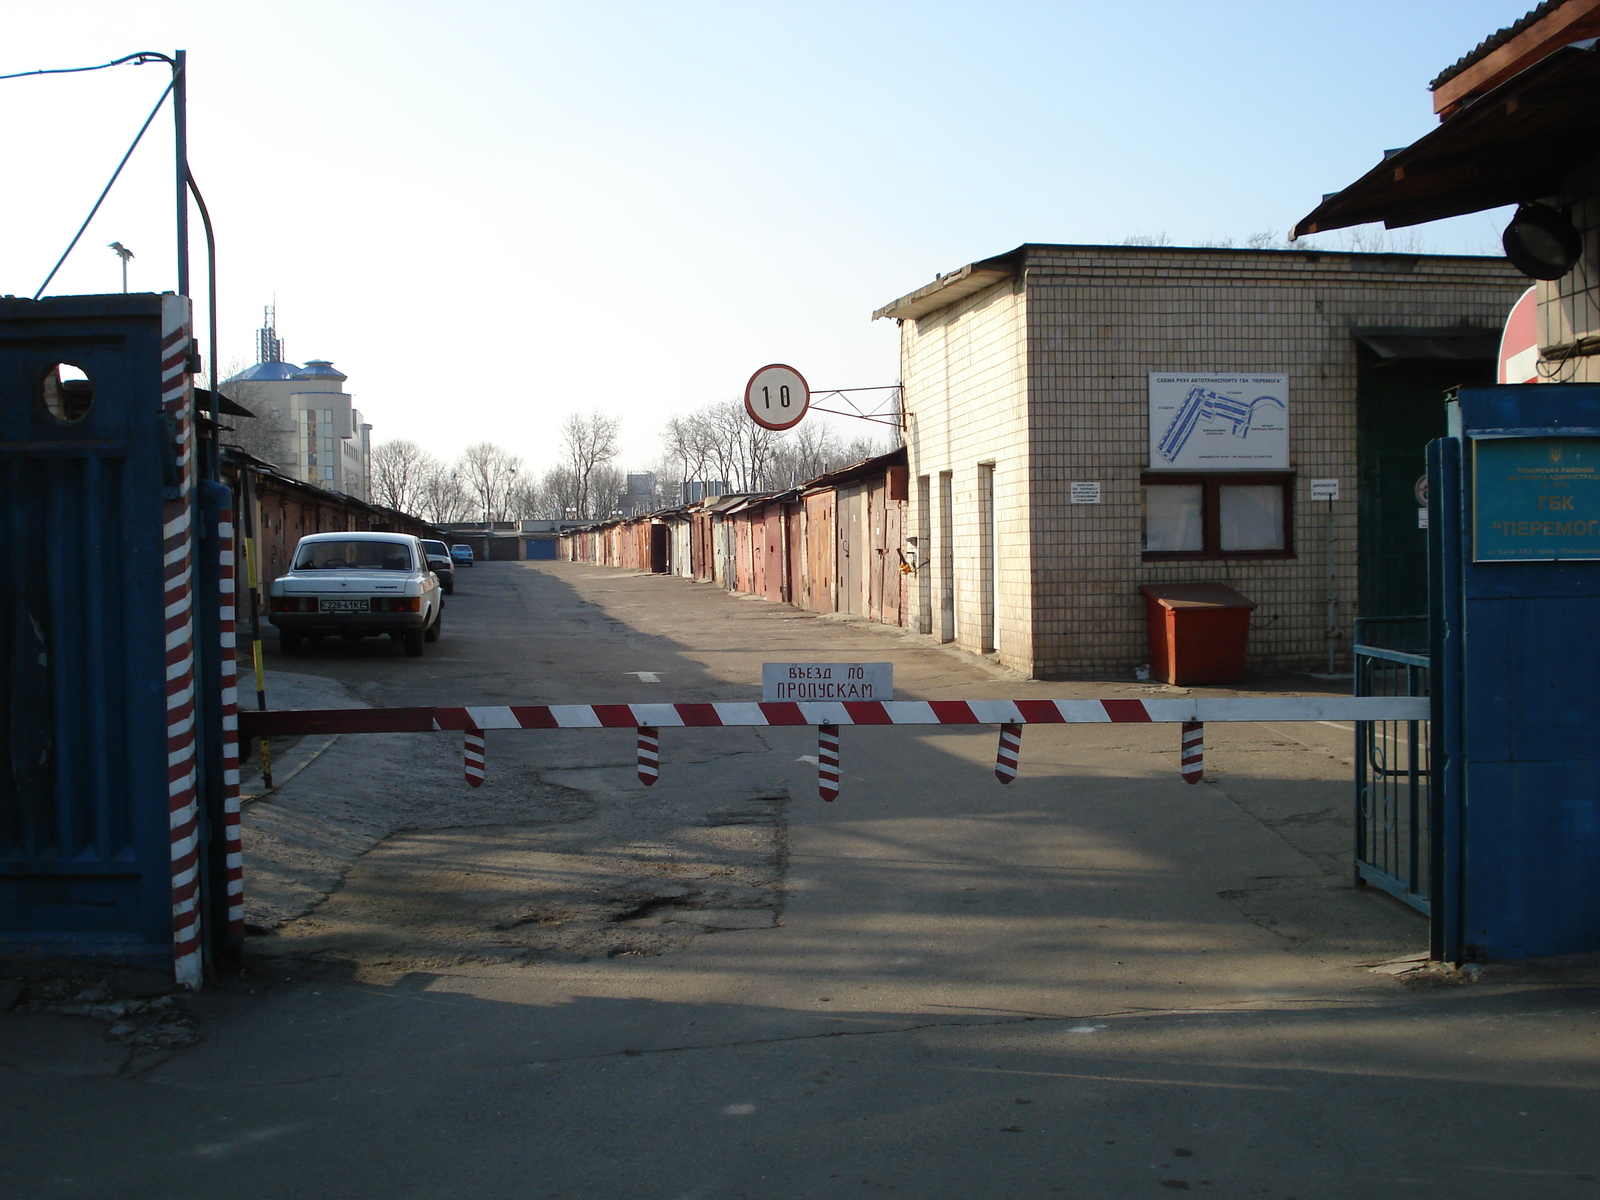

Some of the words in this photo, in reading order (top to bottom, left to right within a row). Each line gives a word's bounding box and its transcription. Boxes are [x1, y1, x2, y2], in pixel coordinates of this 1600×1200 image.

[762, 385, 790, 409] 10
[1537, 495, 1574, 510] ГБК
[1492, 520, 1600, 536] “ПЕРЕМОГ
[789, 667, 832, 679] ВЪЕЗД
[847, 667, 864, 679] ПО
[777, 682, 873, 698] ПРОПУСКАМ
